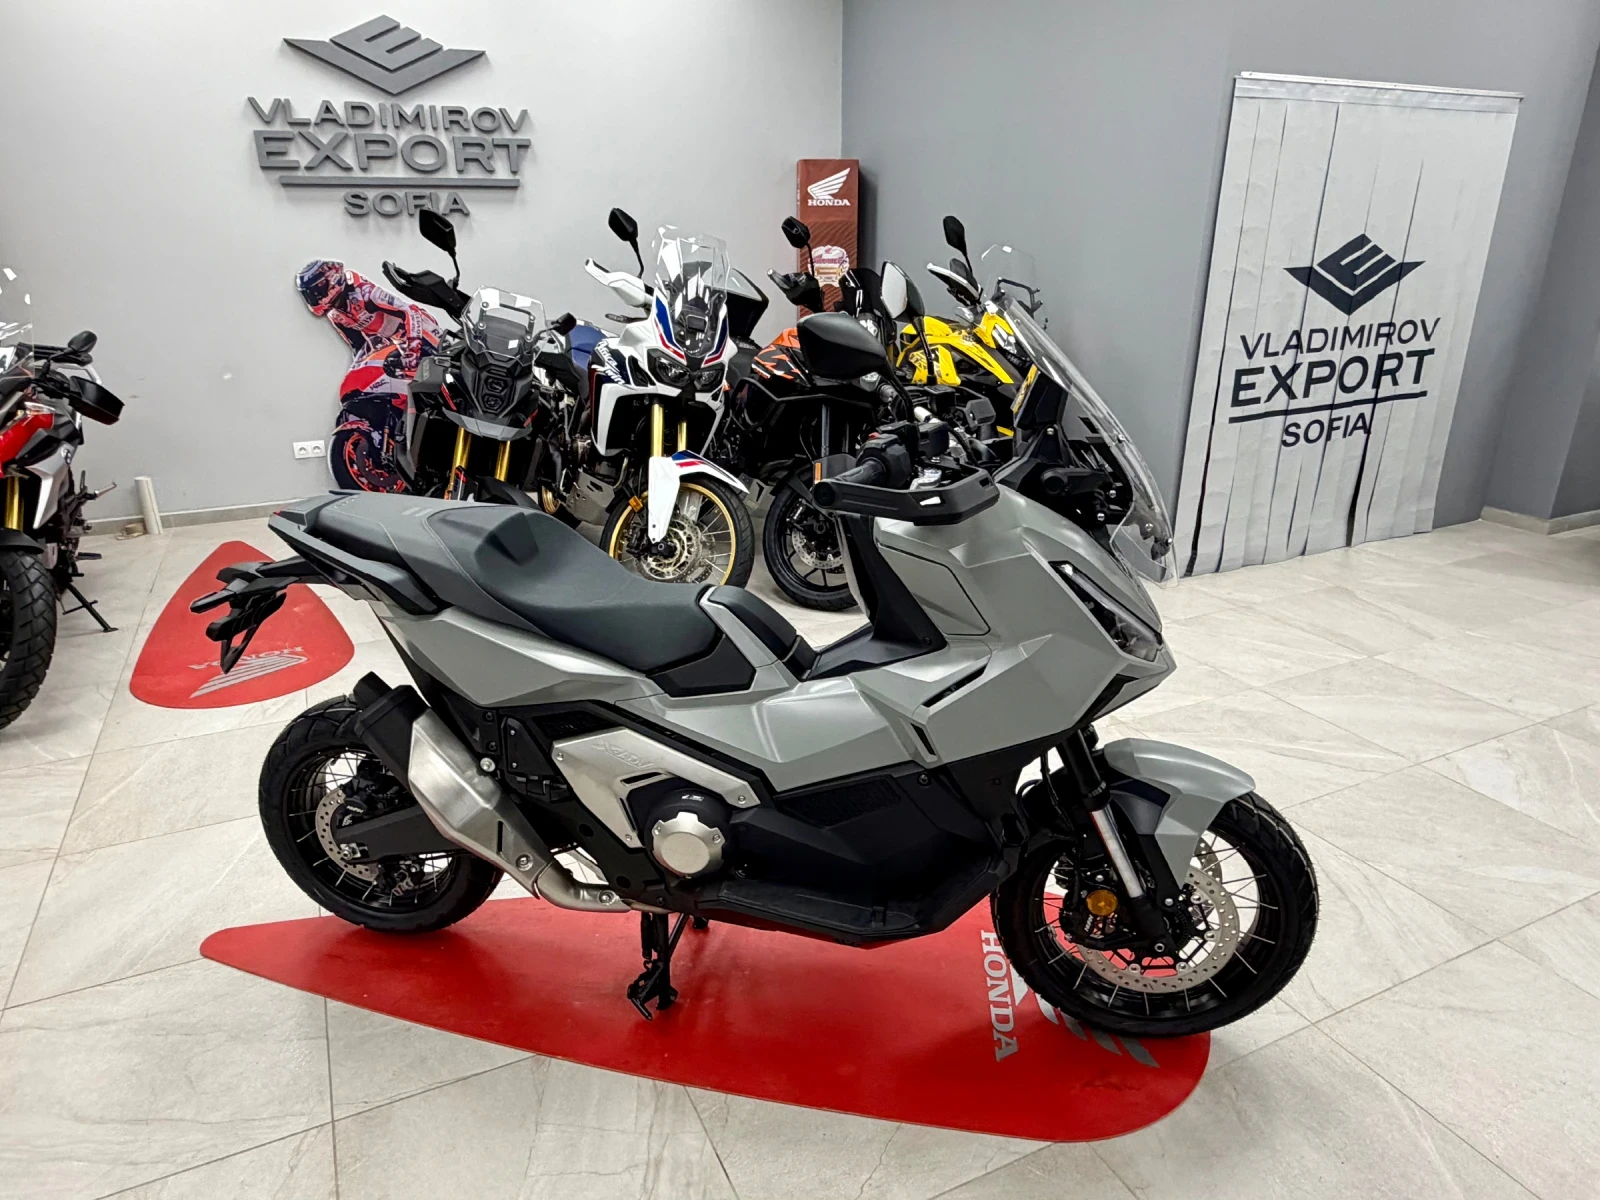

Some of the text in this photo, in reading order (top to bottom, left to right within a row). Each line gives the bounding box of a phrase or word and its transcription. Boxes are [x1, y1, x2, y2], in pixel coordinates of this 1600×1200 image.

[247, 96, 529, 132] VLADIMIROV
[253, 130, 532, 174] EXPORT
[343, 191, 470, 217] SOFIA
[807, 198, 851, 207] HONDA
[1240, 317, 1441, 360] VLADIMIROV
[1230, 348, 1436, 408] EXPORT
[1281, 412, 1372, 447] SOFIA
[980, 929, 1019, 1062] HONDA
